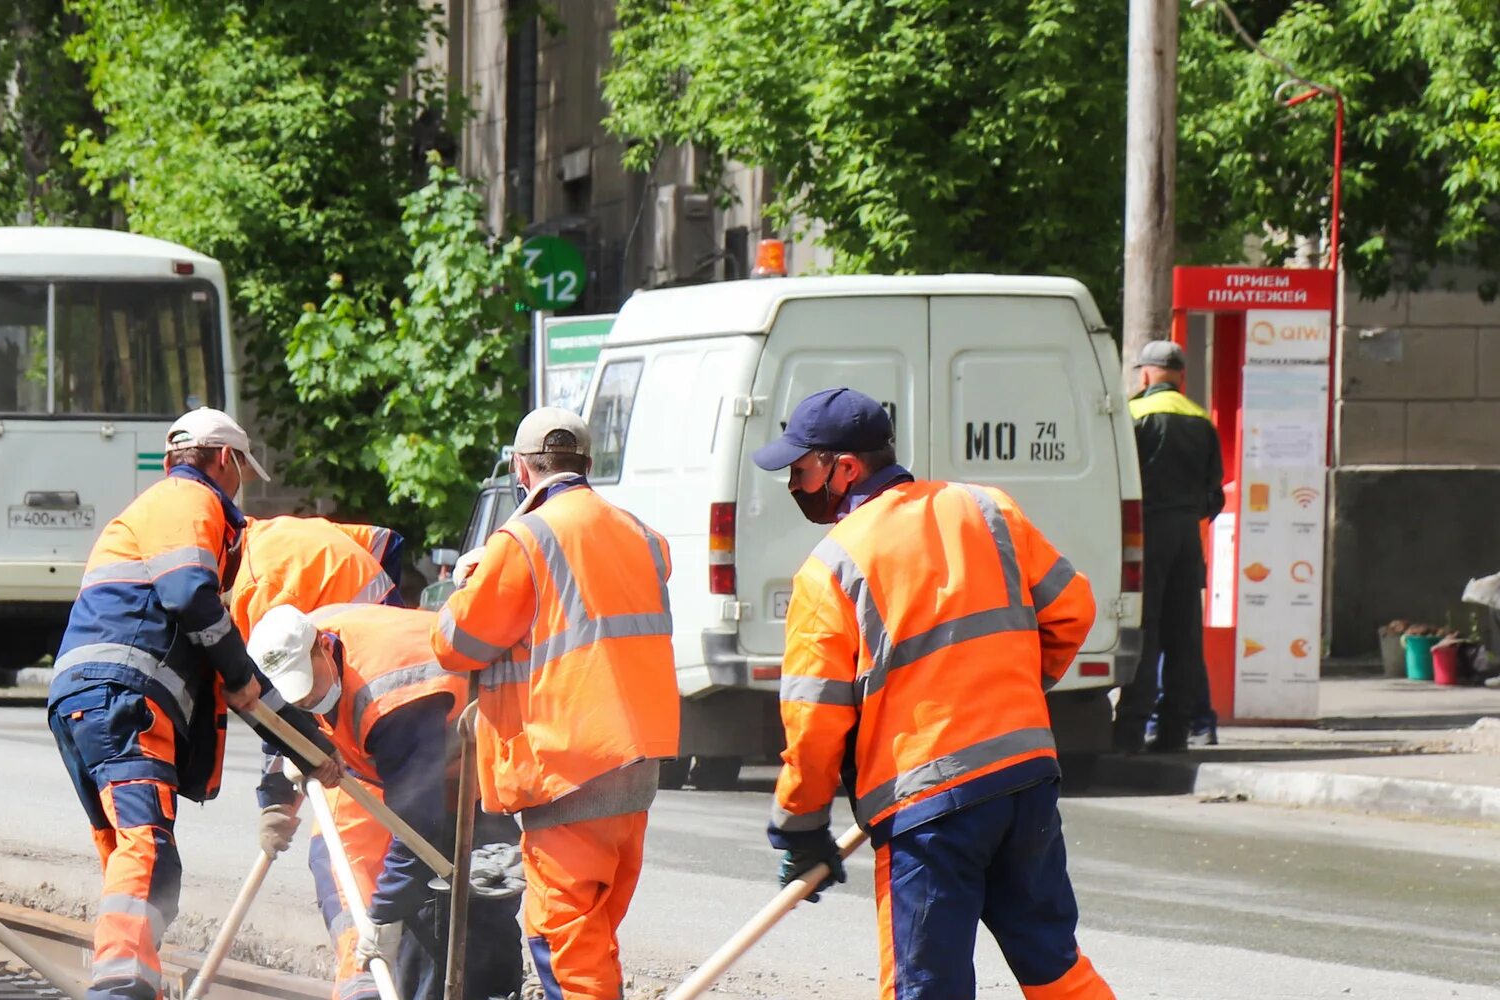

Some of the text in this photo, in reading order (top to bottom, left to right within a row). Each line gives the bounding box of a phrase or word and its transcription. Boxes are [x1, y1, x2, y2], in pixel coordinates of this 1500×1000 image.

[540, 270, 577, 302] 12
[1226, 274, 1290, 288] ПРИЕМ
[1208, 289, 1308, 303] ПЛАТЕЖЕЙ
[1034, 421, 1057, 440] 74
[965, 421, 1016, 461] МО
[1029, 442, 1066, 462] RUS
